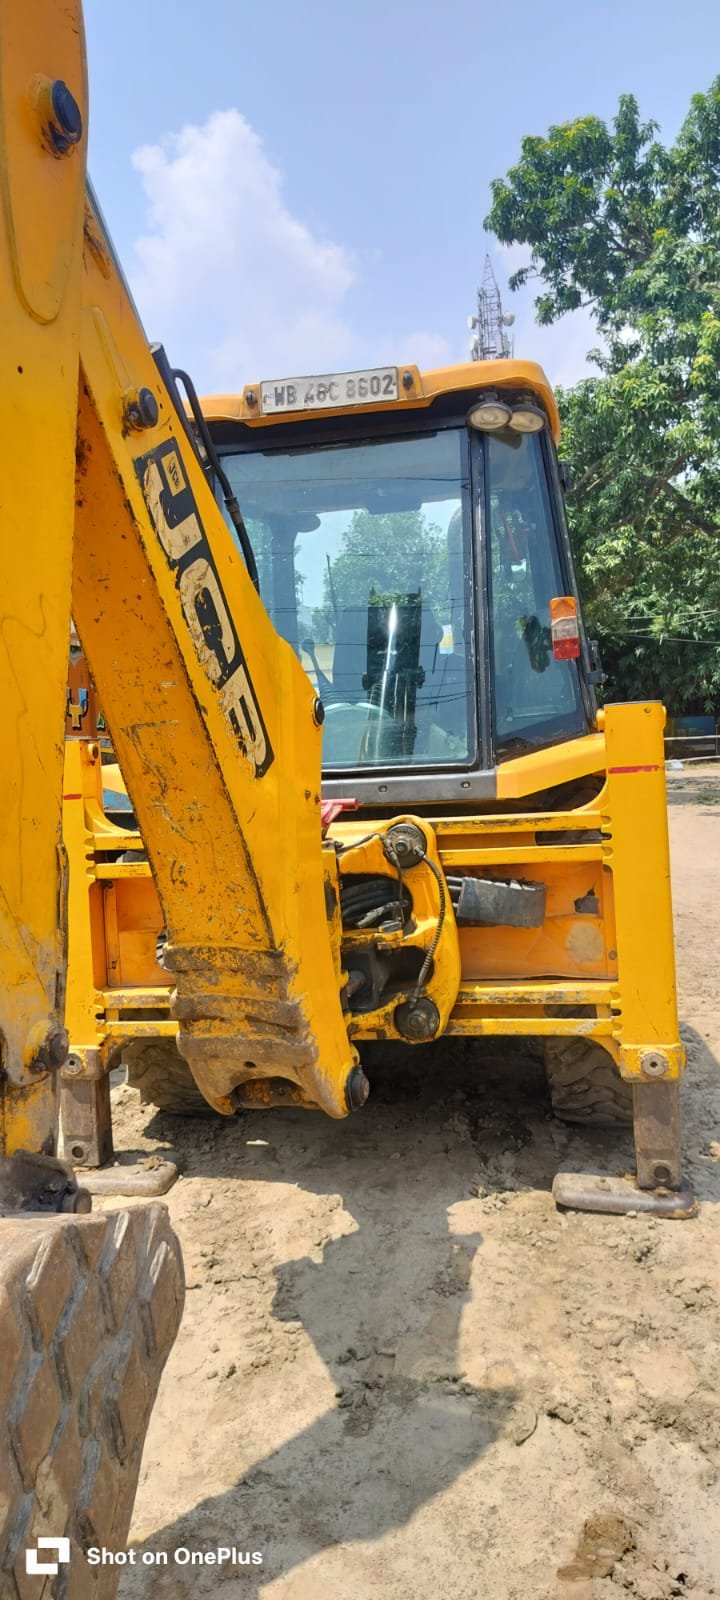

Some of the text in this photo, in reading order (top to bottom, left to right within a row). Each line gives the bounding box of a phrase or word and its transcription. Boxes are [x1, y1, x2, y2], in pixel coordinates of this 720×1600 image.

[274, 385, 297, 407] WB
[346, 374, 394, 398] 8602
[143, 456, 267, 776] JCB
